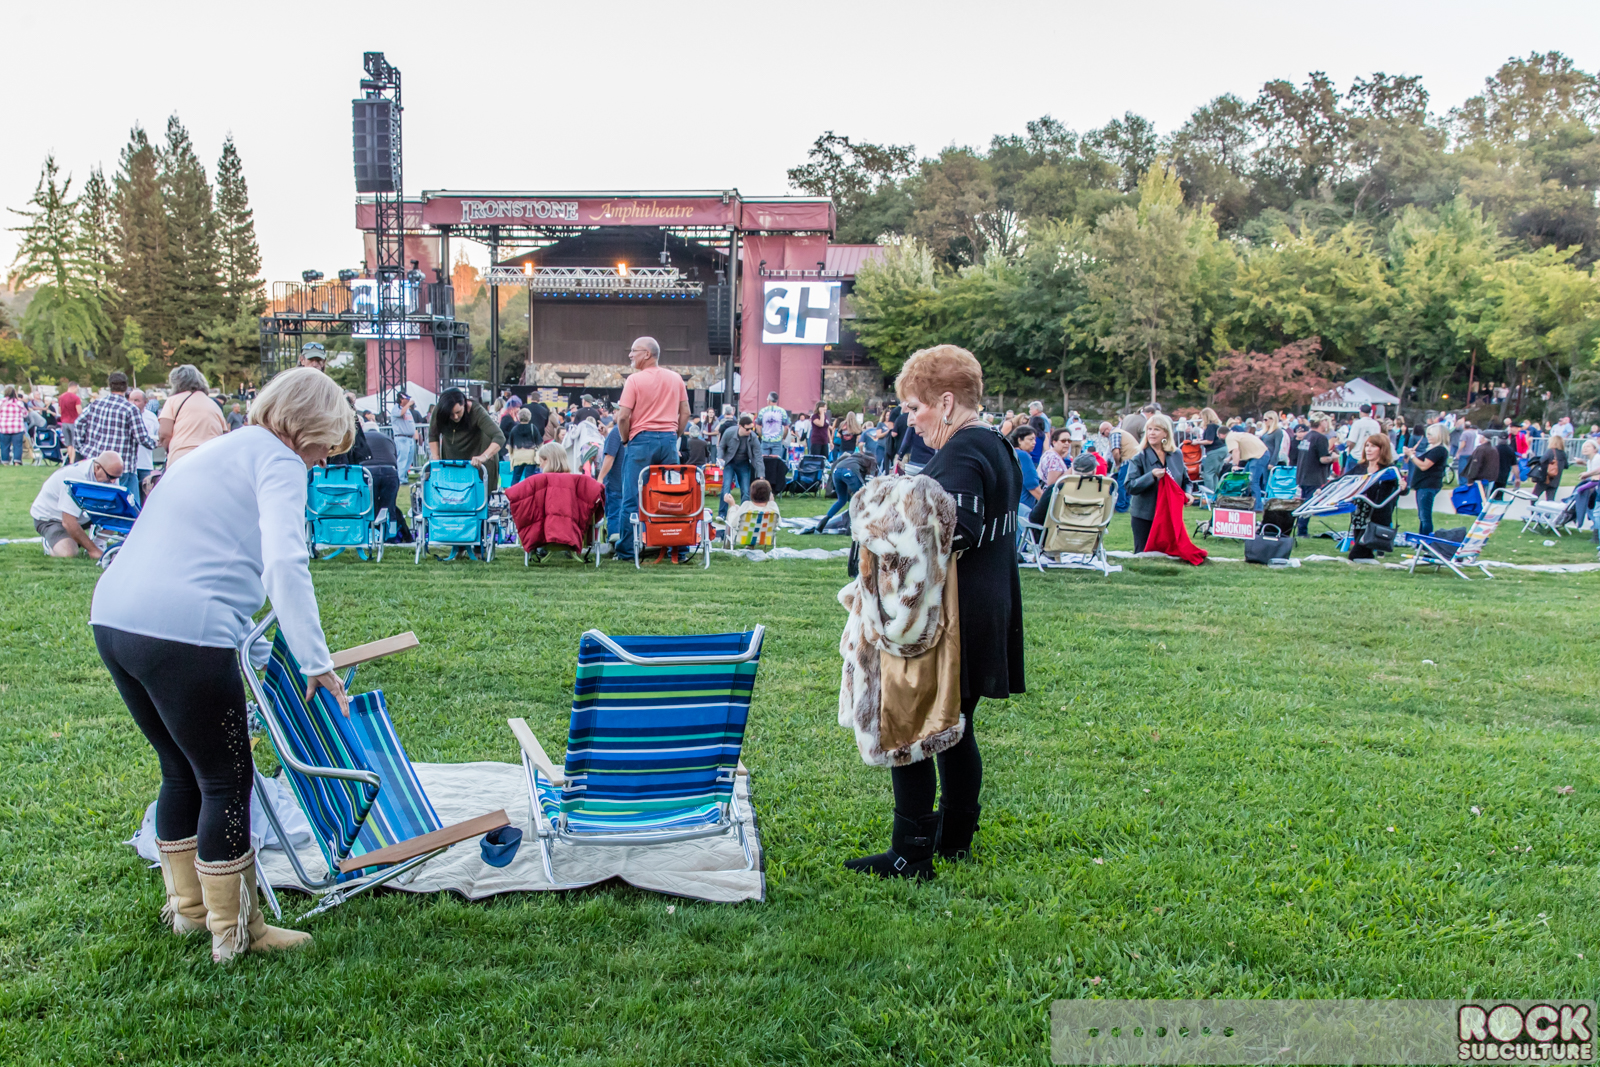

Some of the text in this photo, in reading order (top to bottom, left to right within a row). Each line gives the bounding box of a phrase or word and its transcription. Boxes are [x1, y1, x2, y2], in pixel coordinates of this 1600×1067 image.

[461, 200, 694, 223] IRONSTONE Amphitheatre
[764, 286, 840, 342] GH
[1228, 511, 1240, 523] NO
[1215, 521, 1252, 536] SMOKING
